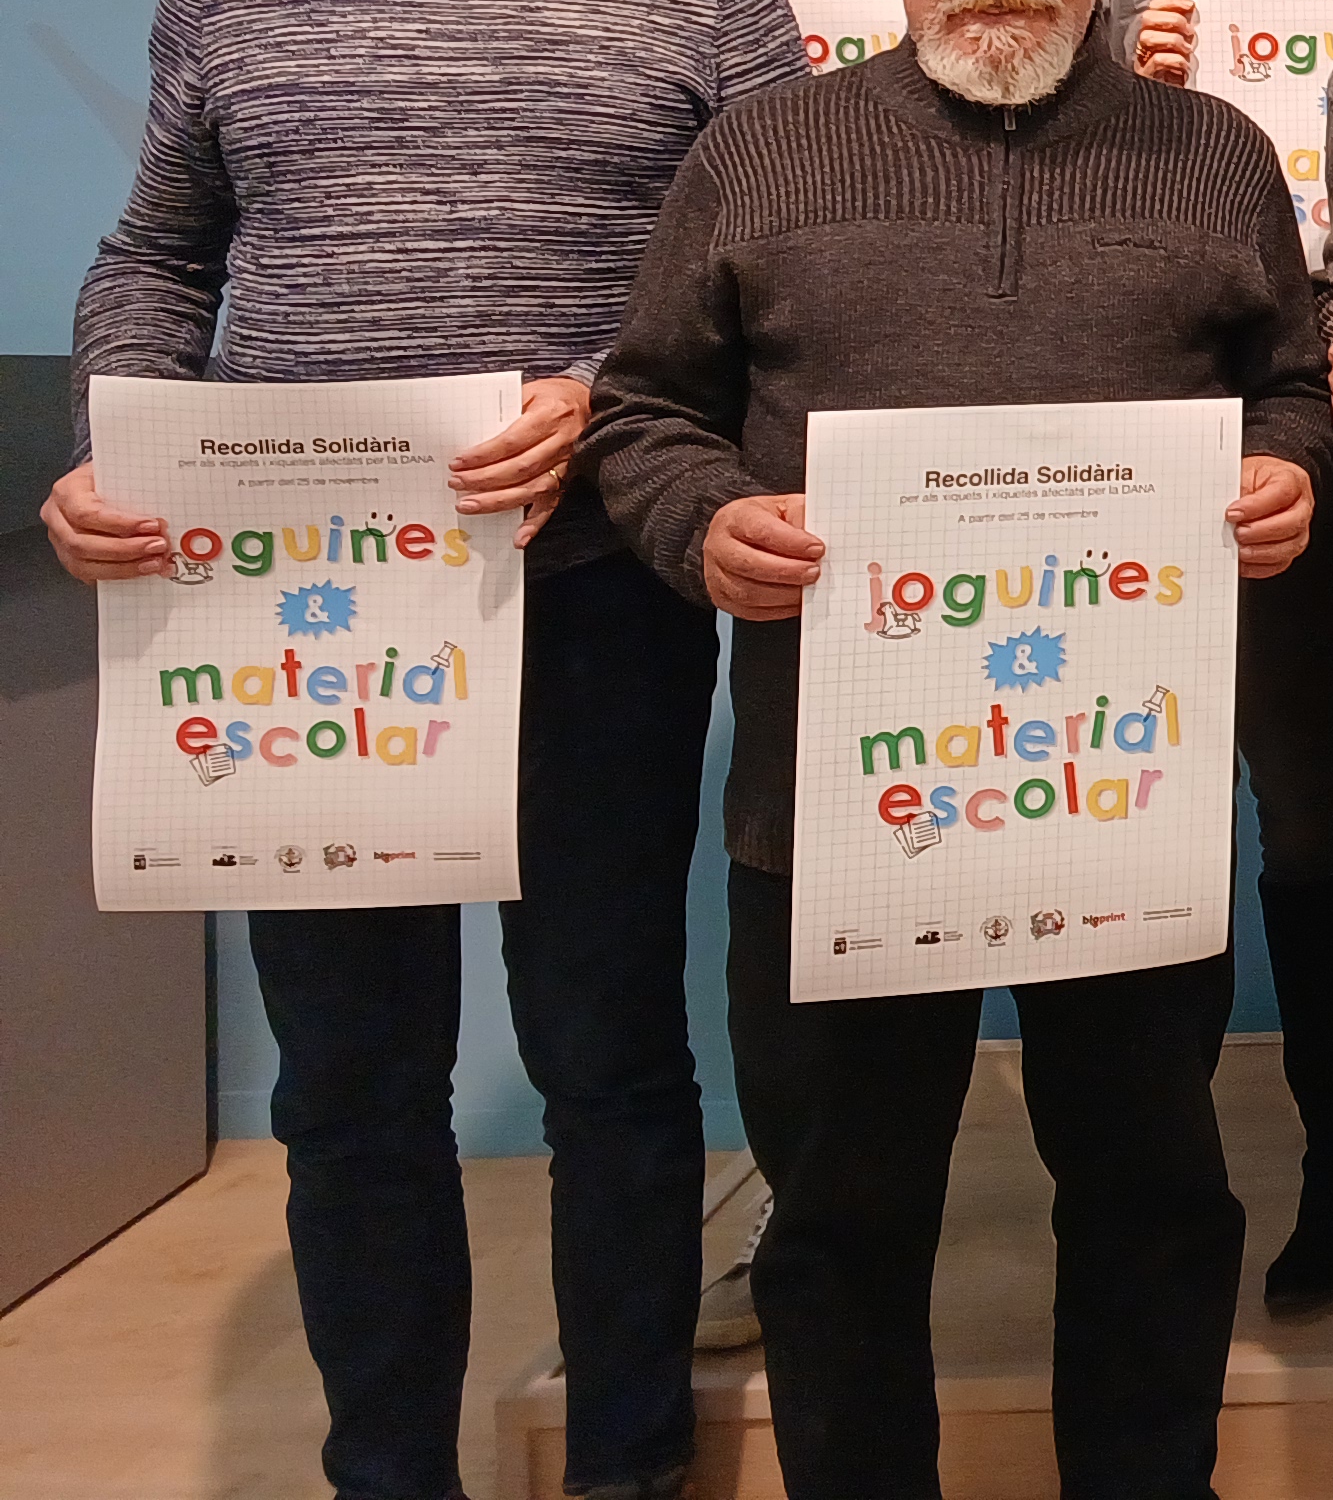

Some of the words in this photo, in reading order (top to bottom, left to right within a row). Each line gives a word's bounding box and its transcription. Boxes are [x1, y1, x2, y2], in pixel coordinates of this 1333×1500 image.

[200, 439, 305, 455] Recollida
[312, 437, 410, 454] Solidària
[925, 468, 1029, 489] Recollida
[1036, 464, 1133, 483] Solidària
[180, 514, 472, 576] oguines
[303, 593, 330, 625] &
[159, 647, 468, 707] material
[1011, 644, 1039, 676] &
[176, 708, 451, 767] escolar
[860, 692, 1182, 776] material
[878, 761, 1164, 832] escolar
